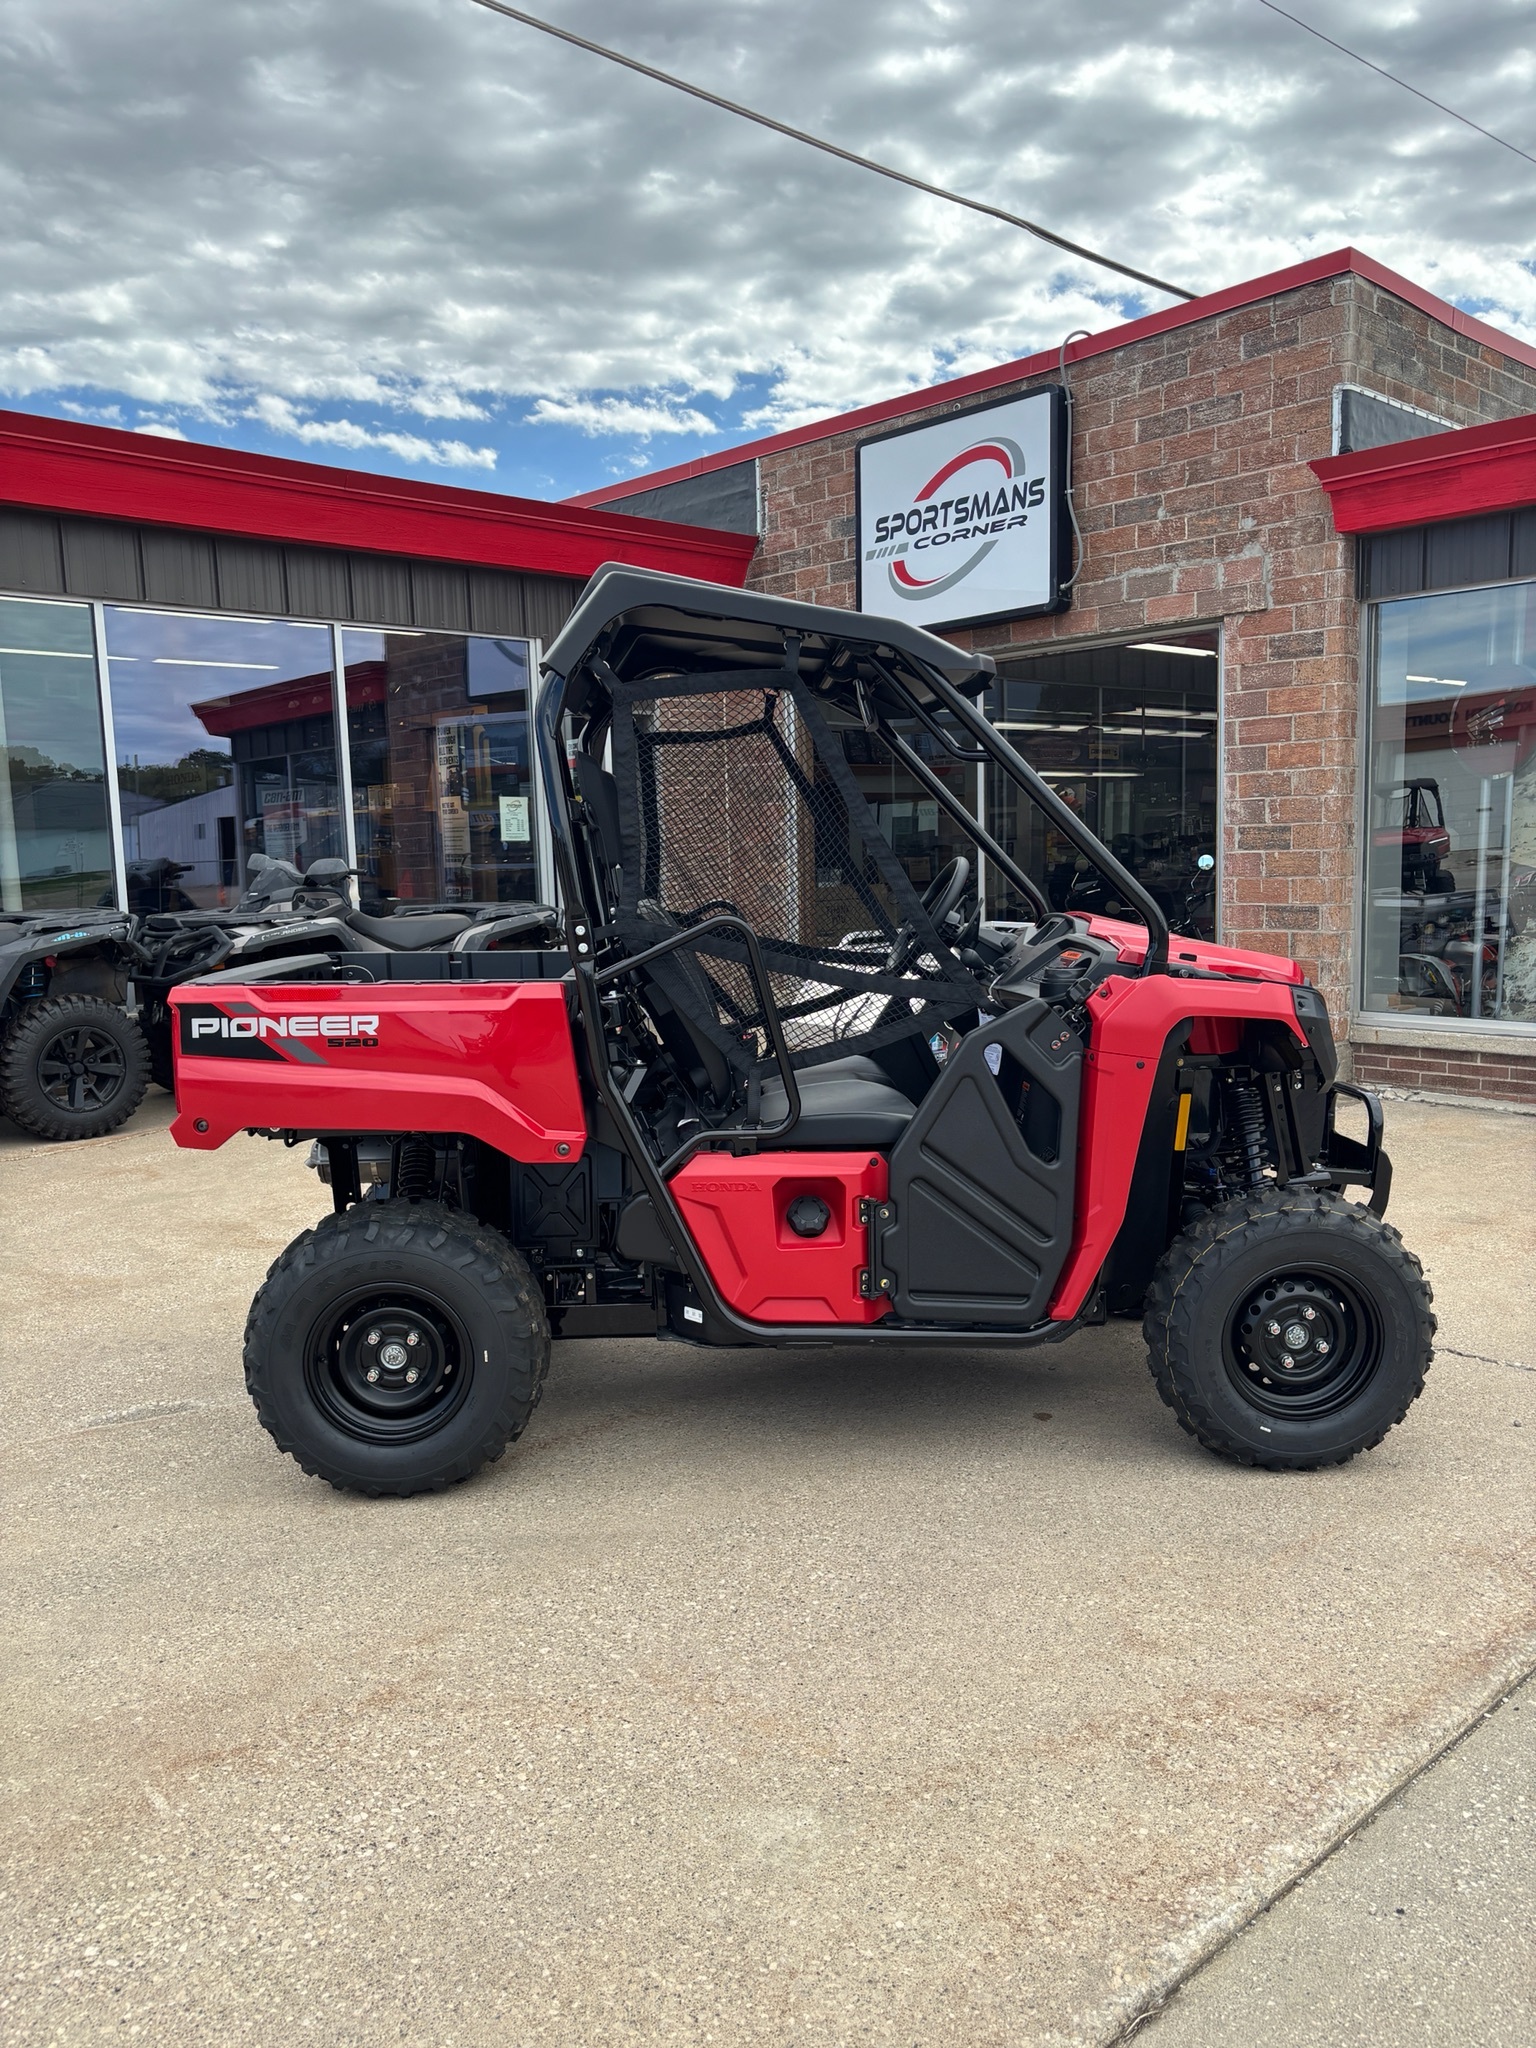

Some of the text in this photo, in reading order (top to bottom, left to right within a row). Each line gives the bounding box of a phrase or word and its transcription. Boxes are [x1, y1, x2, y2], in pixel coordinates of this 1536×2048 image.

[874, 476, 1046, 544] SPORTSMANS
[913, 514, 1029, 550] CORNER
[190, 1015, 379, 1039] PIONEER
[327, 1037, 379, 1048] 520
[691, 1181, 762, 1193] HONDA
